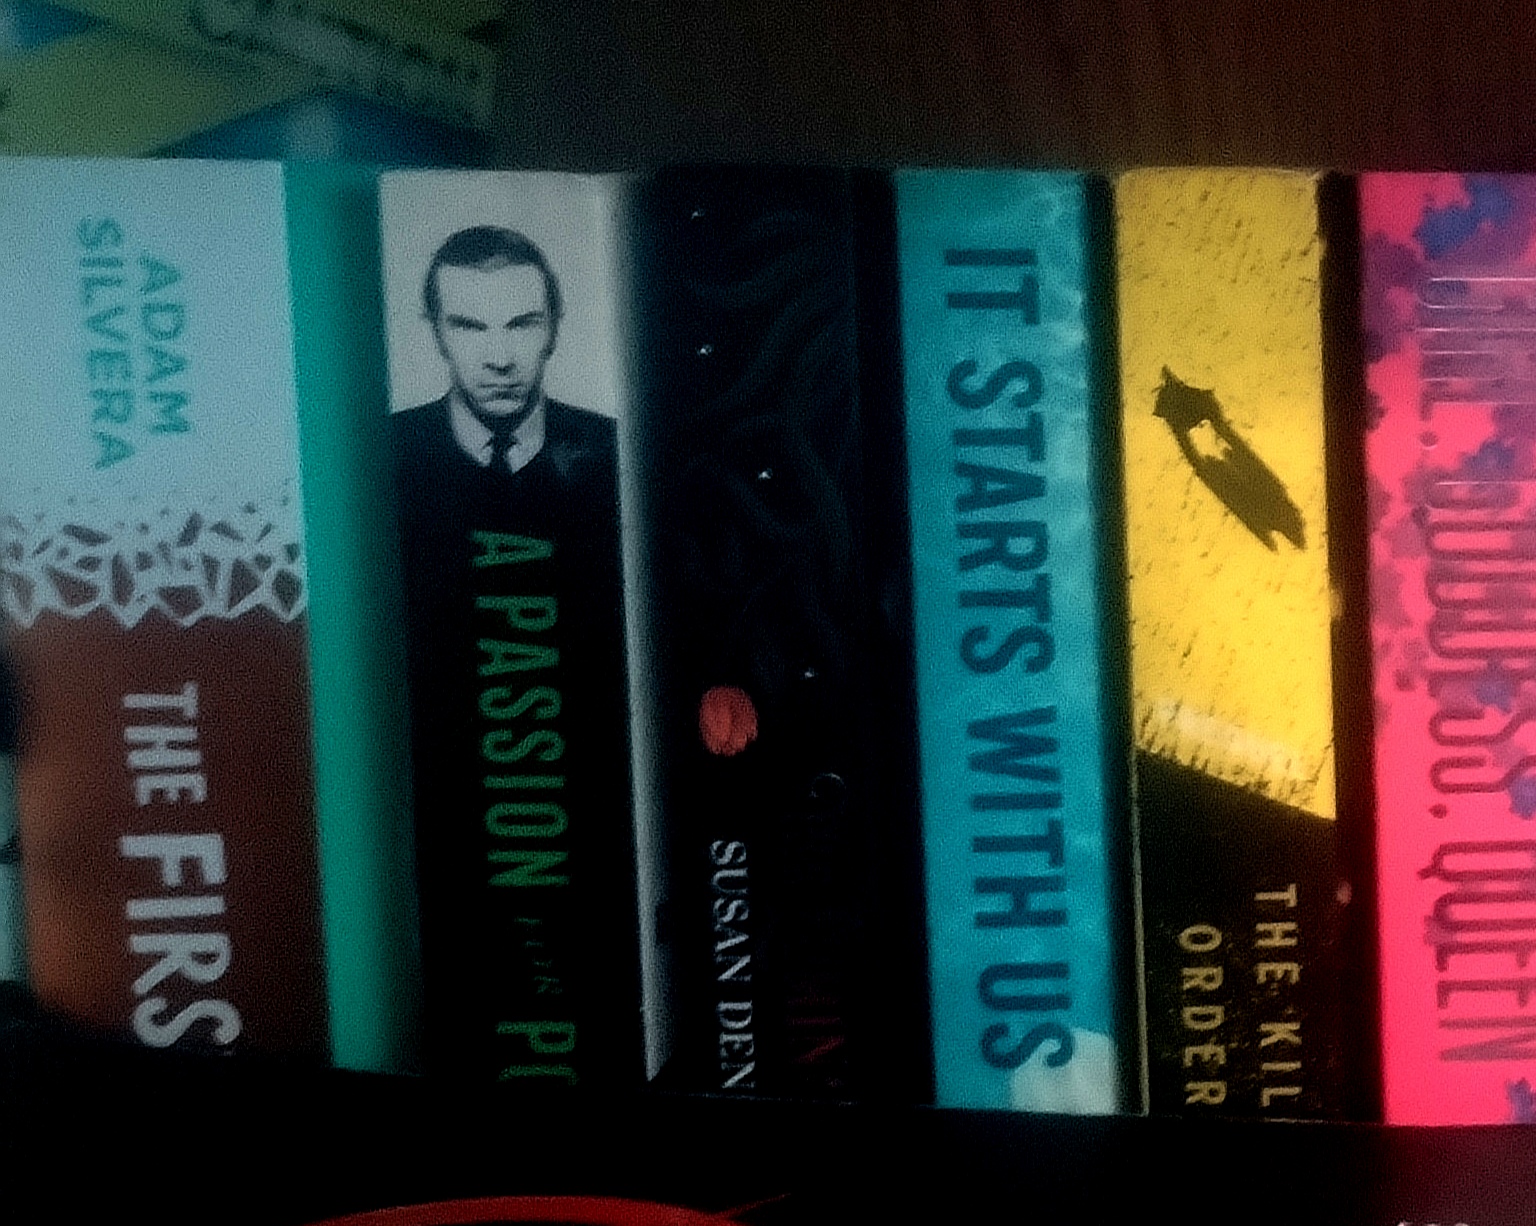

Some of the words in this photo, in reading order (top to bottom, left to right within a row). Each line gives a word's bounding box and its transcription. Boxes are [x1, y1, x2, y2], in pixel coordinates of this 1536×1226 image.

[76, 216, 136, 470] SILVERA
[139, 251, 192, 438] ADAM
[944, 247, 1042, 327] IT
[467, 528, 556, 569] A
[946, 357, 1056, 675] STARTS
[121, 681, 208, 806] THE
[472, 595, 572, 889] PASSION
[966, 704, 1068, 930] WITH
[119, 832, 245, 1050] FIRS
[710, 839, 753, 983] SUSAN
[1253, 882, 1303, 986] THE
[714, 999, 757, 1091] DEN
[976, 961, 1073, 1072] US
[1175, 922, 1228, 1107] ORDER
[1255, 1011, 1303, 1109] KIL
